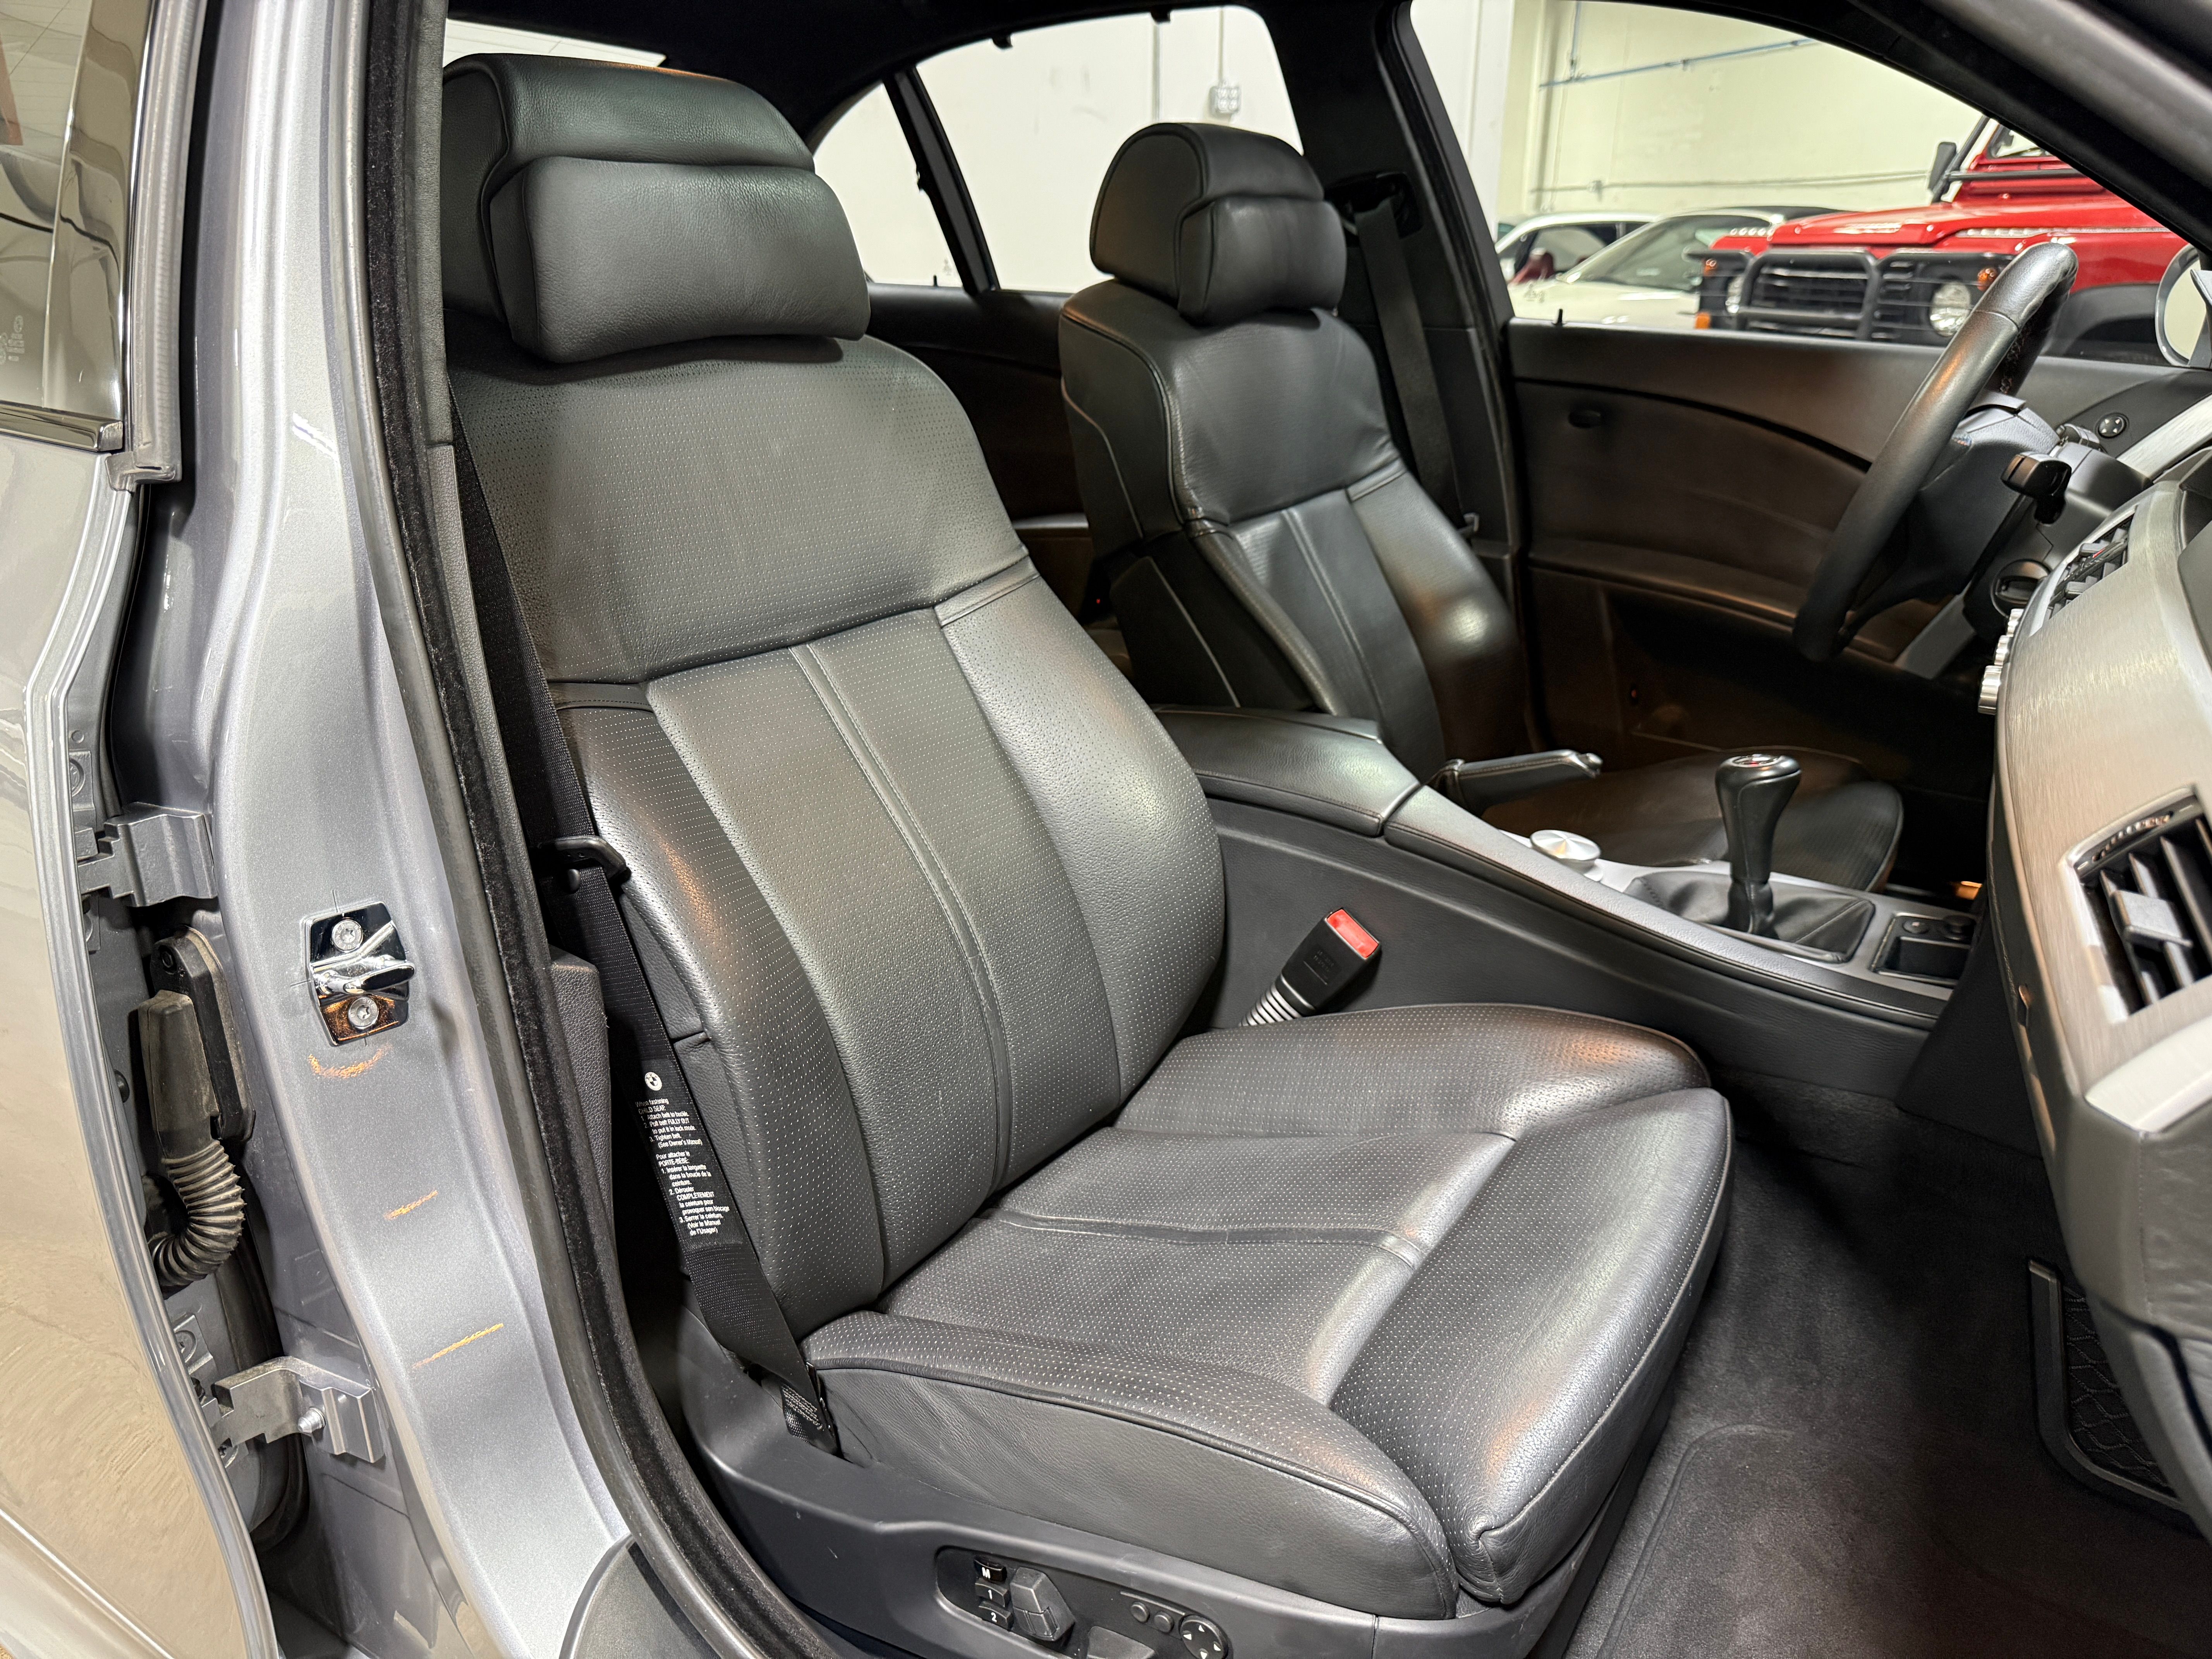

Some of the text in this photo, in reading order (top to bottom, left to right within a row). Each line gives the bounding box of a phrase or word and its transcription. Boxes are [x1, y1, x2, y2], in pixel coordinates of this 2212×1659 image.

[982, 1567, 990, 1578] M
[988, 1590, 992, 1600] 1
[991, 1612, 997, 1622] 2
